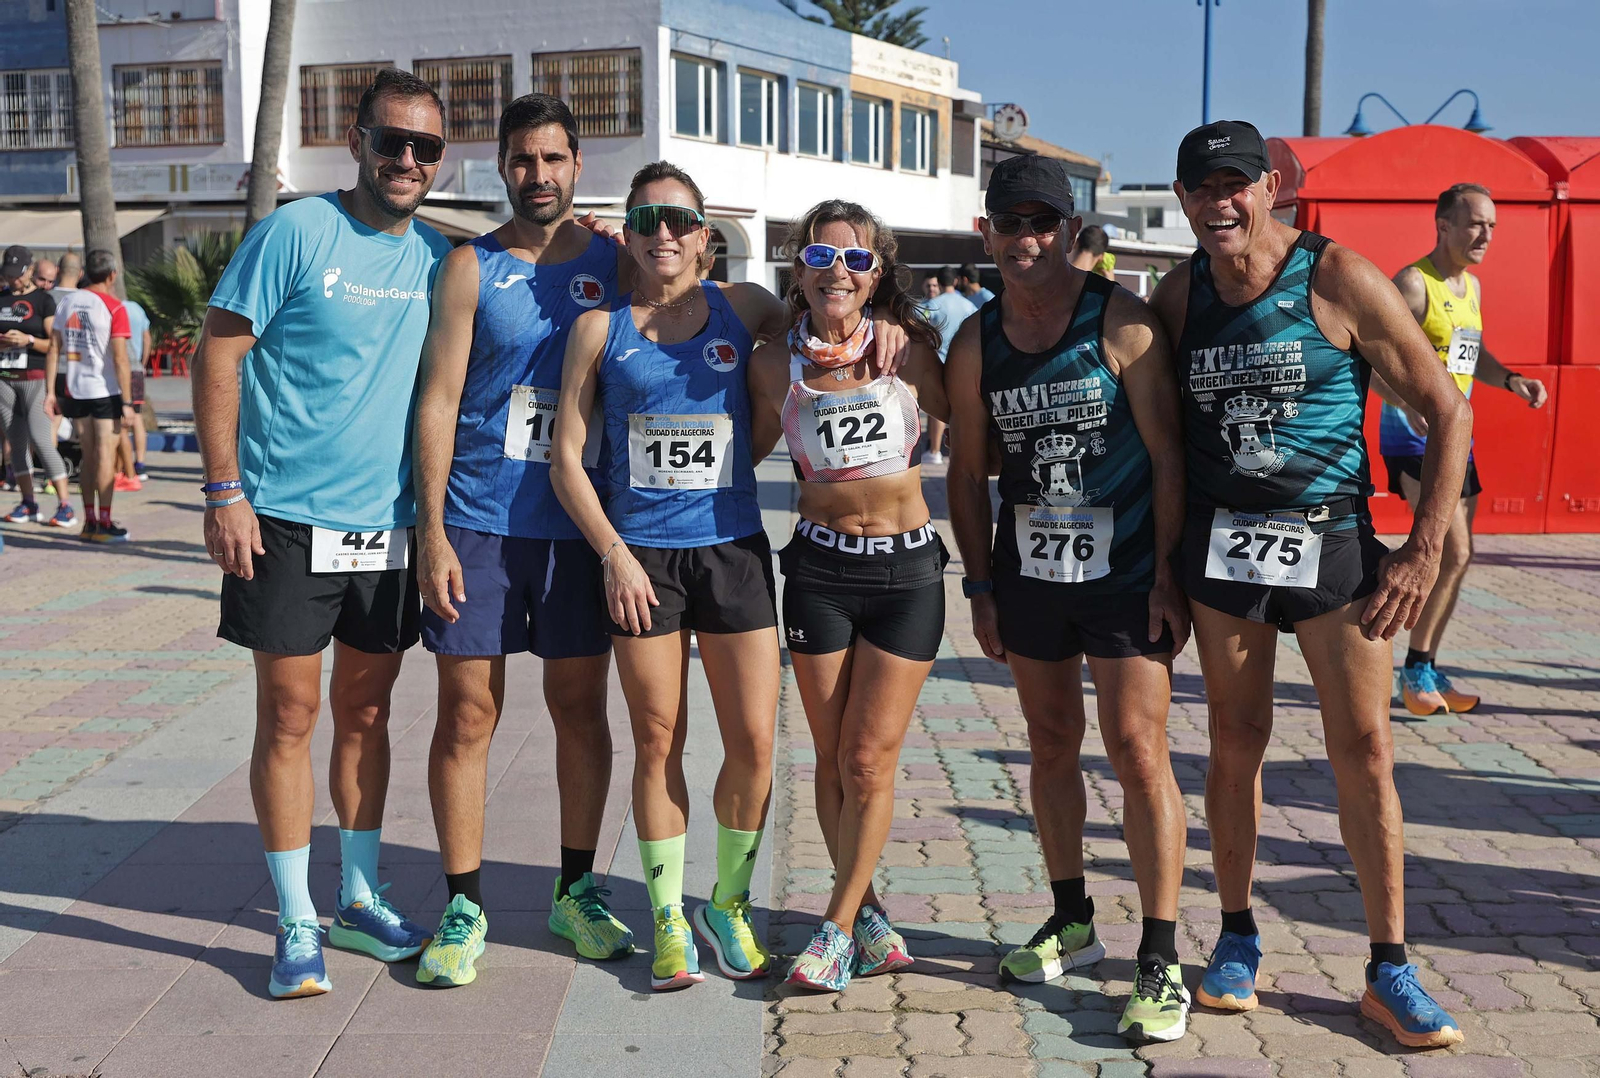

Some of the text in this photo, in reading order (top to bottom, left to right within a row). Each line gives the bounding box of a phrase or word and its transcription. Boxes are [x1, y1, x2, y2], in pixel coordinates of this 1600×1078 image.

[343, 294, 376, 306] PODÓLOGA
[1190, 341, 1302, 374] XXVI CARRERA
[1246, 353, 1303, 366] POPULAR
[1190, 368, 1303, 389] VIRGEN DEL PILAR
[989, 377, 1101, 415] XXVI CARRERA
[1051, 388, 1103, 405] POPULAR
[1271, 384, 1305, 394] 2024
[528, 401, 558, 412] CIUDAD D
[813, 406, 838, 418] CIUDAD
[838, 404, 847, 413] DE
[999, 404, 1105, 429] VIRGEN DEL PILAR
[1077, 417, 1107, 431] 2024
[645, 421, 714, 429] CARRERA URBANA
[671, 429, 680, 437] DE
[680, 428, 715, 437] ALGECIRAS
[816, 412, 888, 449] 122
[645, 440, 715, 469] 154
[1029, 520, 1049, 529] CIUDAD
[1059, 521, 1094, 530] ALGECIRAS
[1232, 519, 1305, 534] CIUDAD DE ALGECIRAS
[342, 530, 385, 550] 42
[1029, 532, 1095, 562] 276
[1226, 531, 1303, 566] 275
